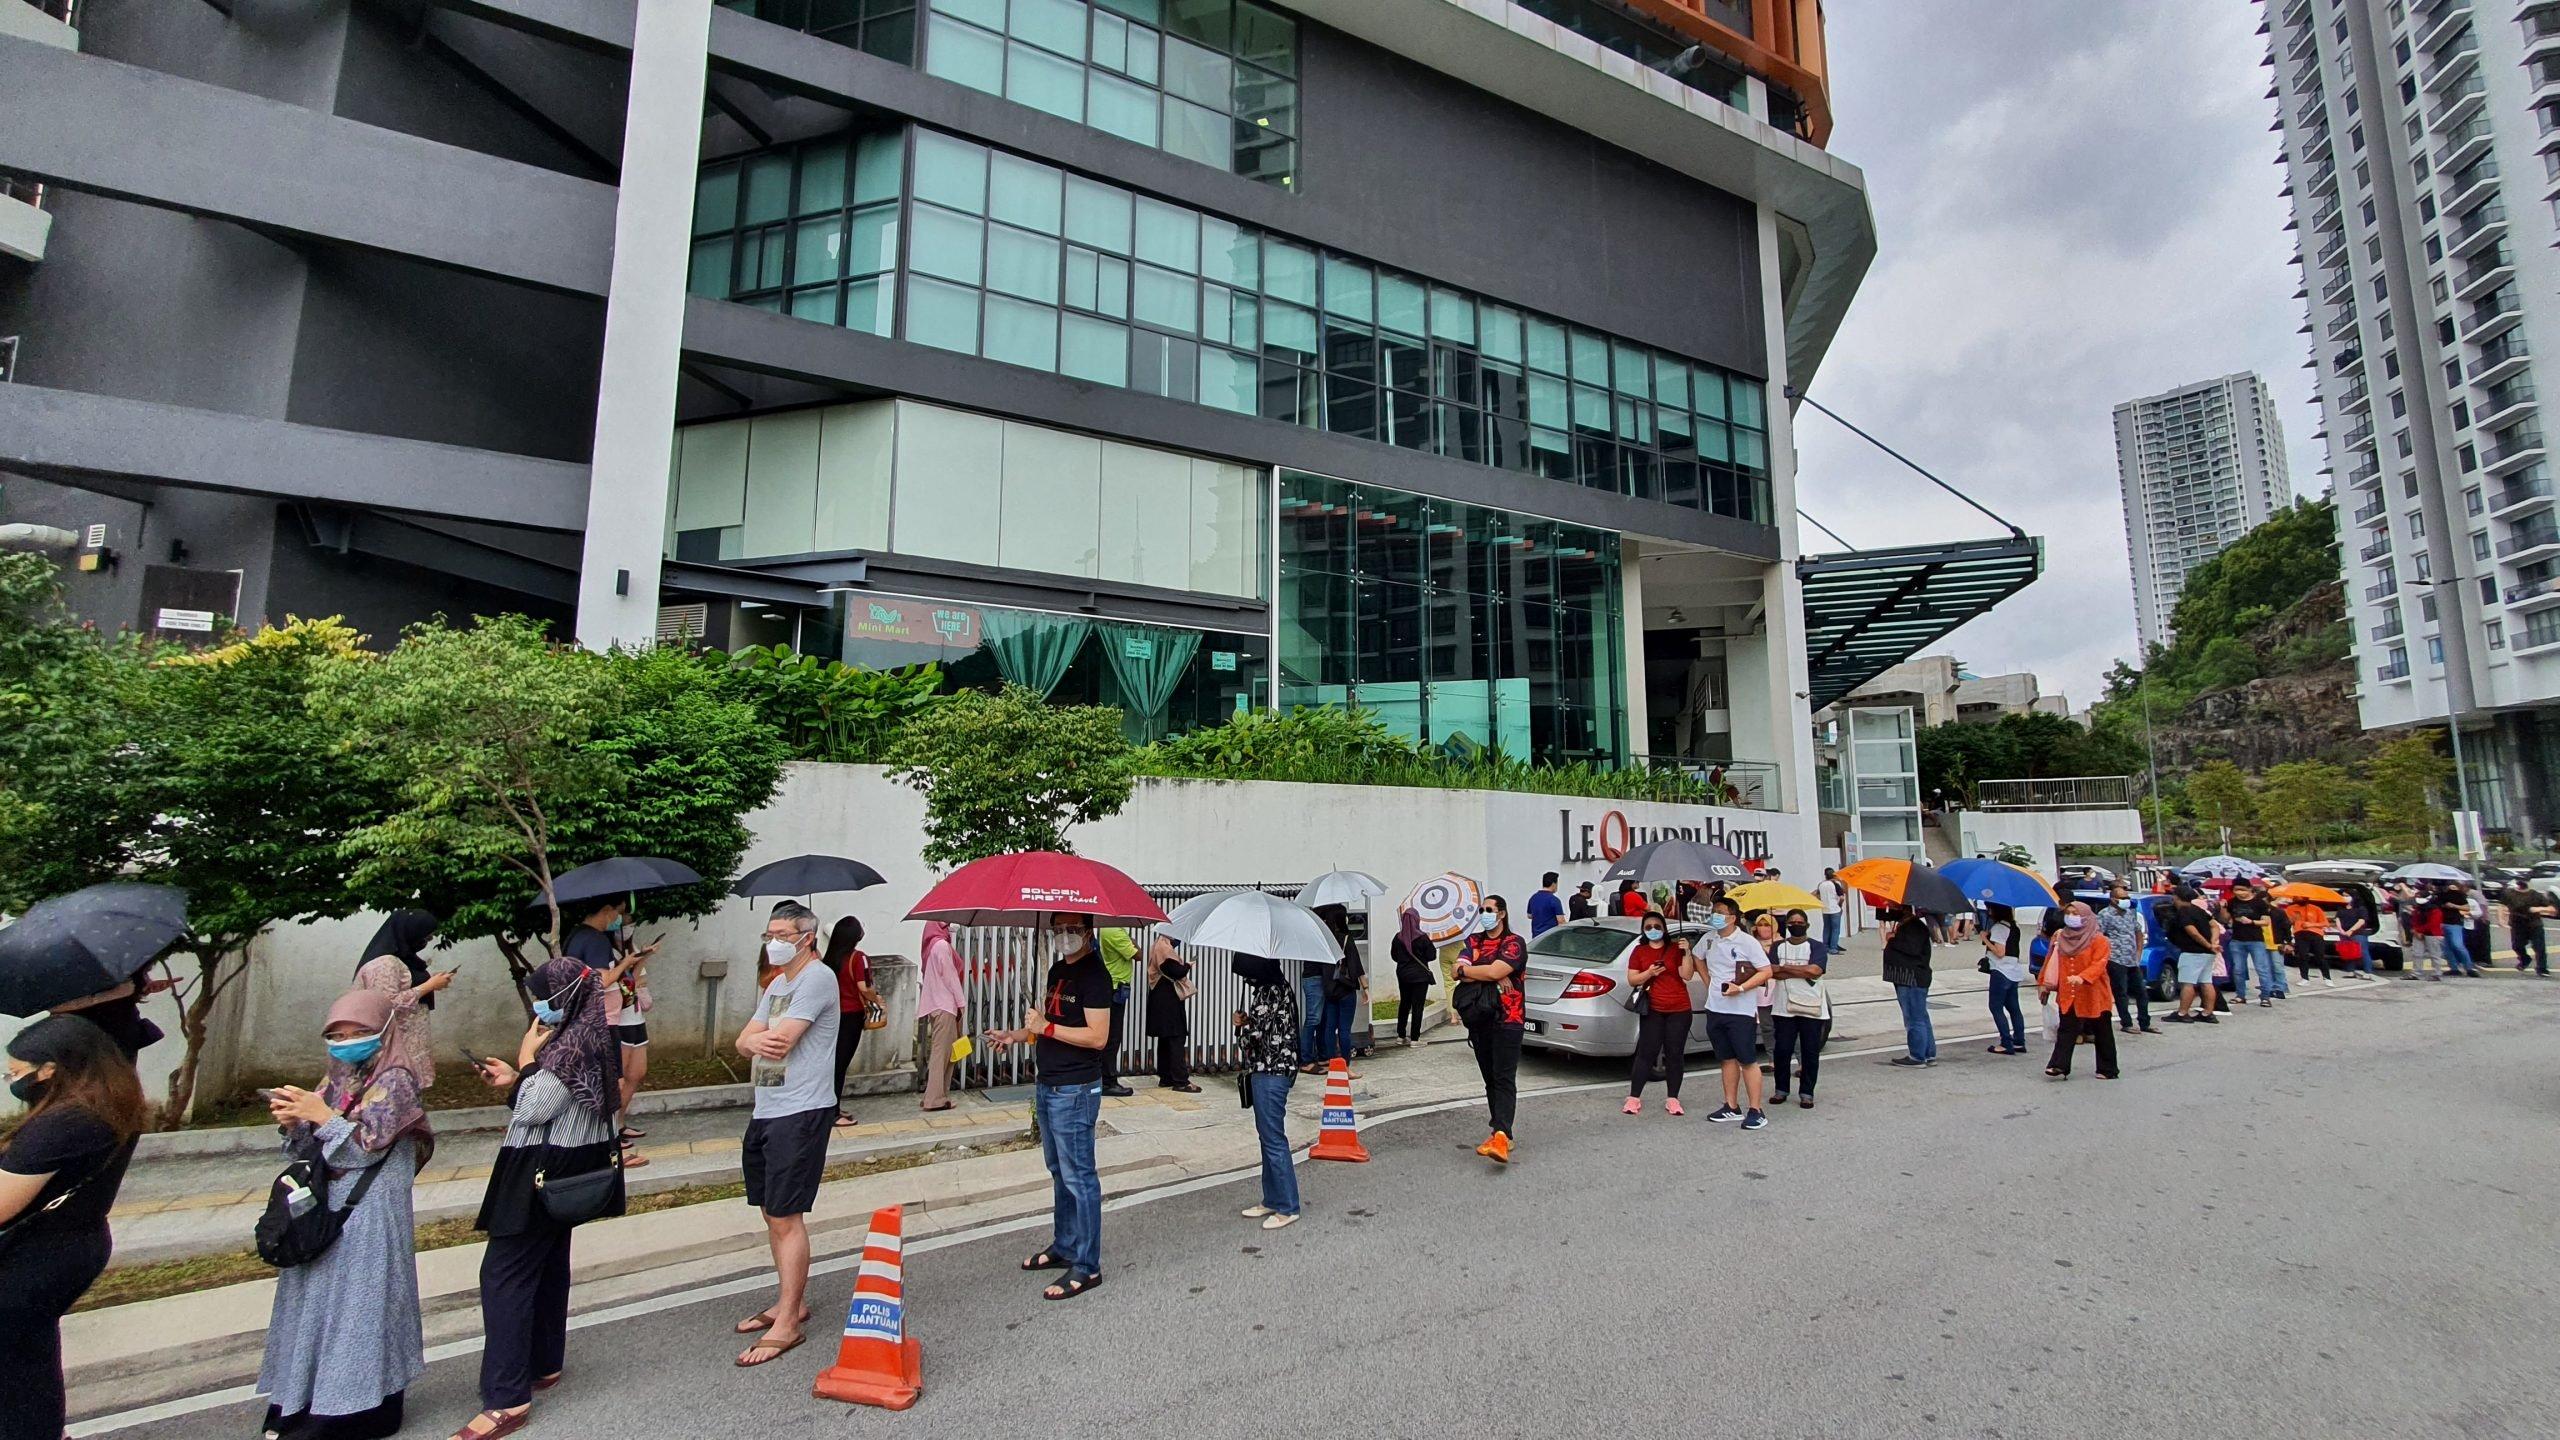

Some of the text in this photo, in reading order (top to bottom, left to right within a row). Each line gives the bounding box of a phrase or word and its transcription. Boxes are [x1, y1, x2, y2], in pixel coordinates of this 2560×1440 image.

[858, 622, 910, 635] Mini Mart
[940, 621, 961, 632] HERE
[1560, 809, 1595, 863] LE
[1705, 816, 1774, 860] HOTEL
[1021, 887, 1080, 896] GOLDEN
[1069, 895, 1098, 904] travel
[862, 1303, 890, 1317] POLIS
[850, 1313, 898, 1330] BANTUAN
